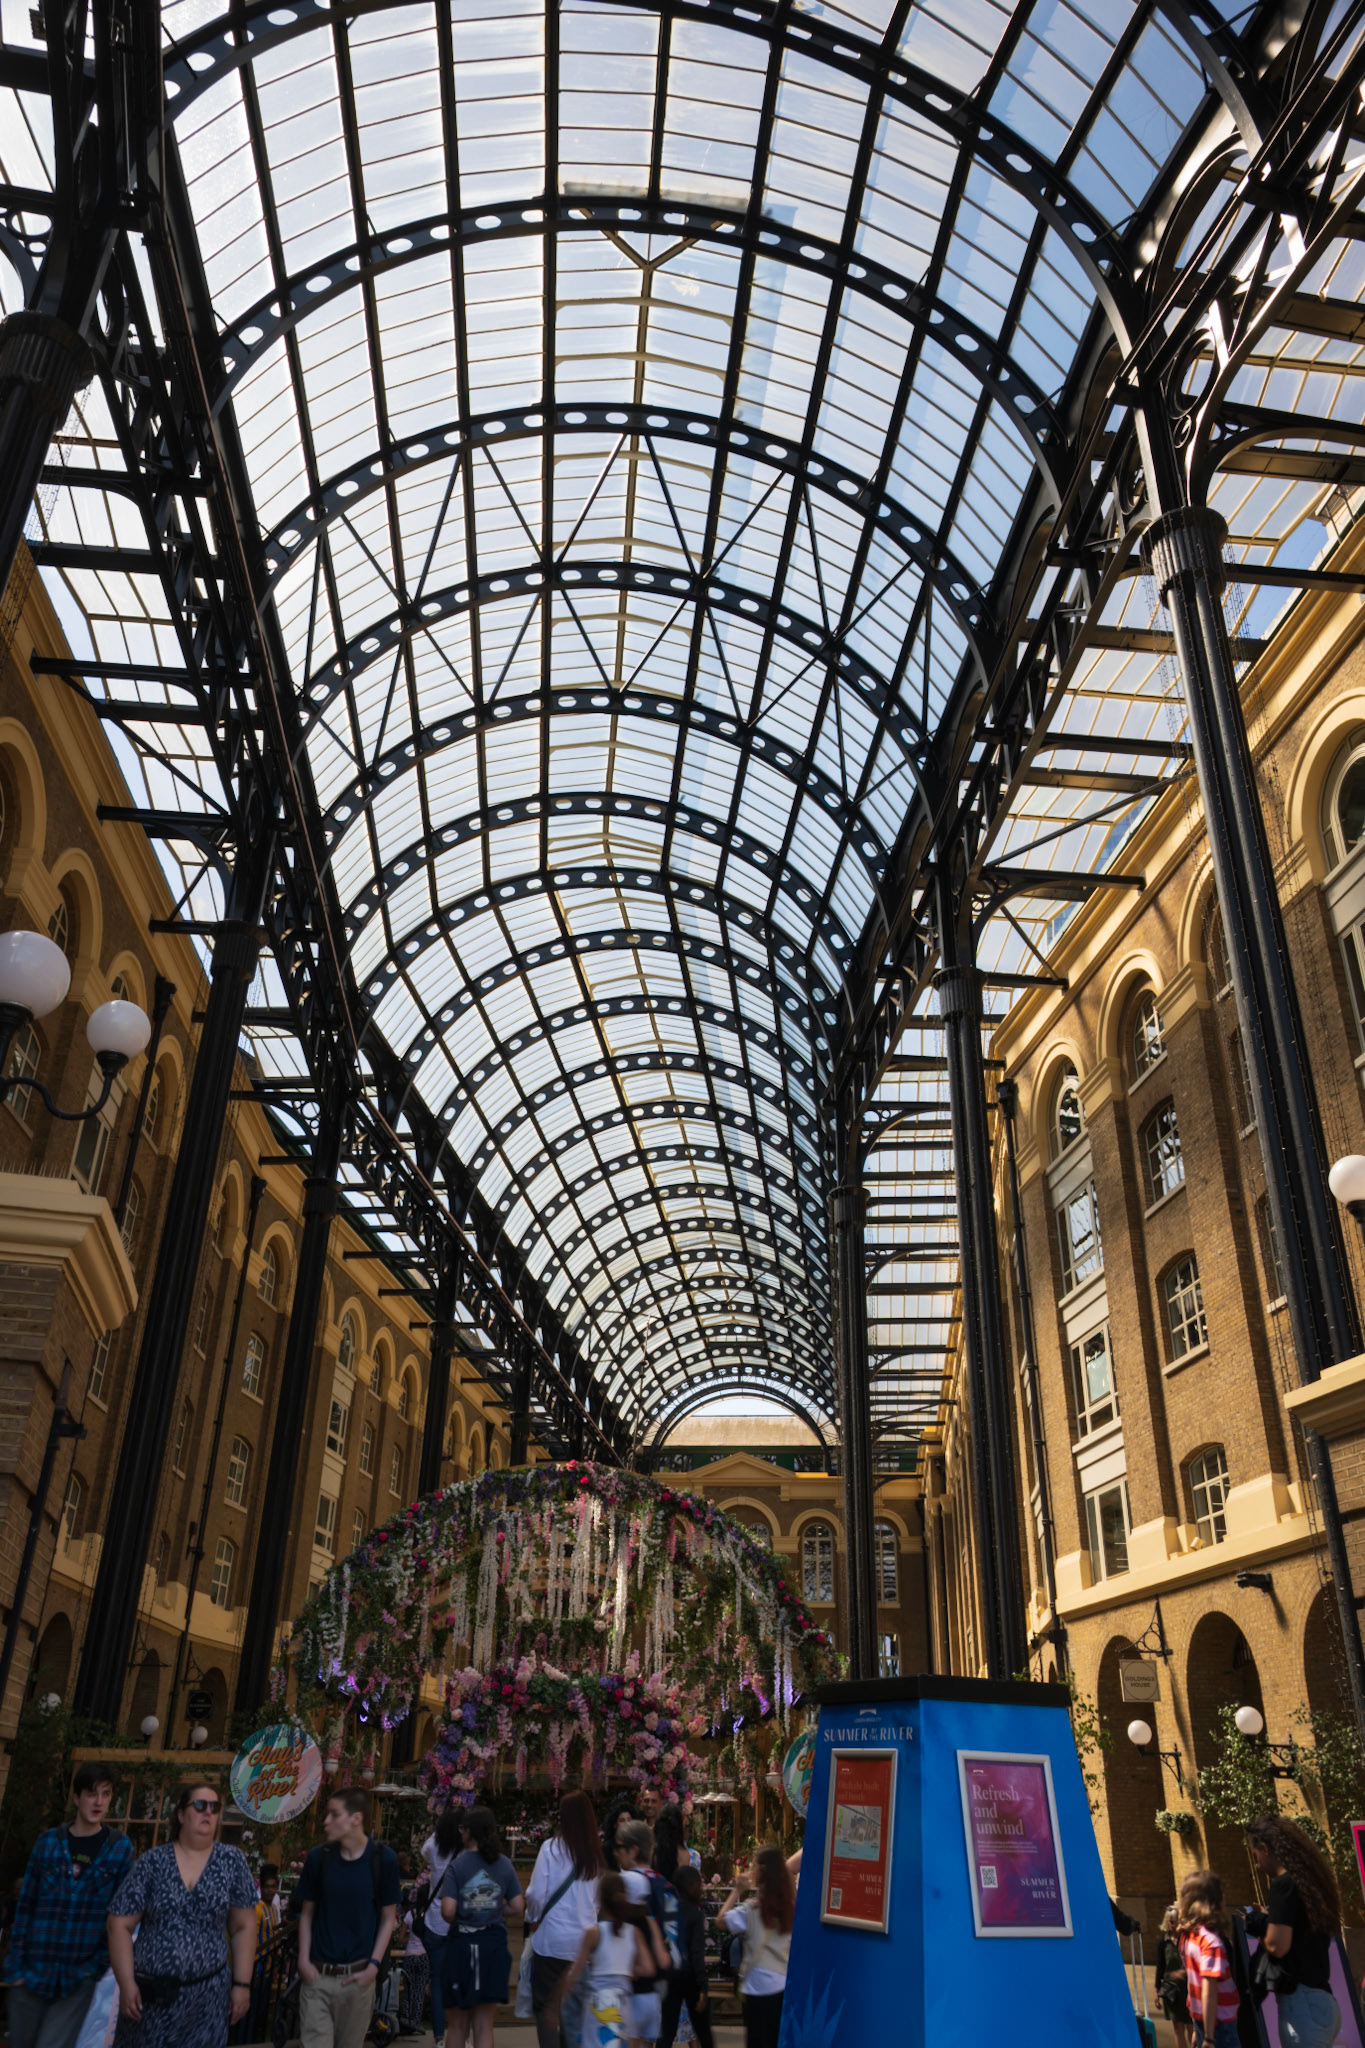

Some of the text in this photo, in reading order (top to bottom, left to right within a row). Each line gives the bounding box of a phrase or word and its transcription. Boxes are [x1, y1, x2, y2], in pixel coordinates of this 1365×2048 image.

[823, 1727, 868, 1742] SUMMER
[879, 1726, 913, 1741] RIVER
[248, 1739, 304, 1769] Hay's
[247, 1776, 298, 1809] River
[972, 1784, 1020, 1801] Refresh
[974, 1803, 998, 1819] and
[976, 1819, 1024, 1836] unwind
[1021, 1878, 1055, 1887] SUMMER
[1032, 1890, 1057, 1899] RIVER
